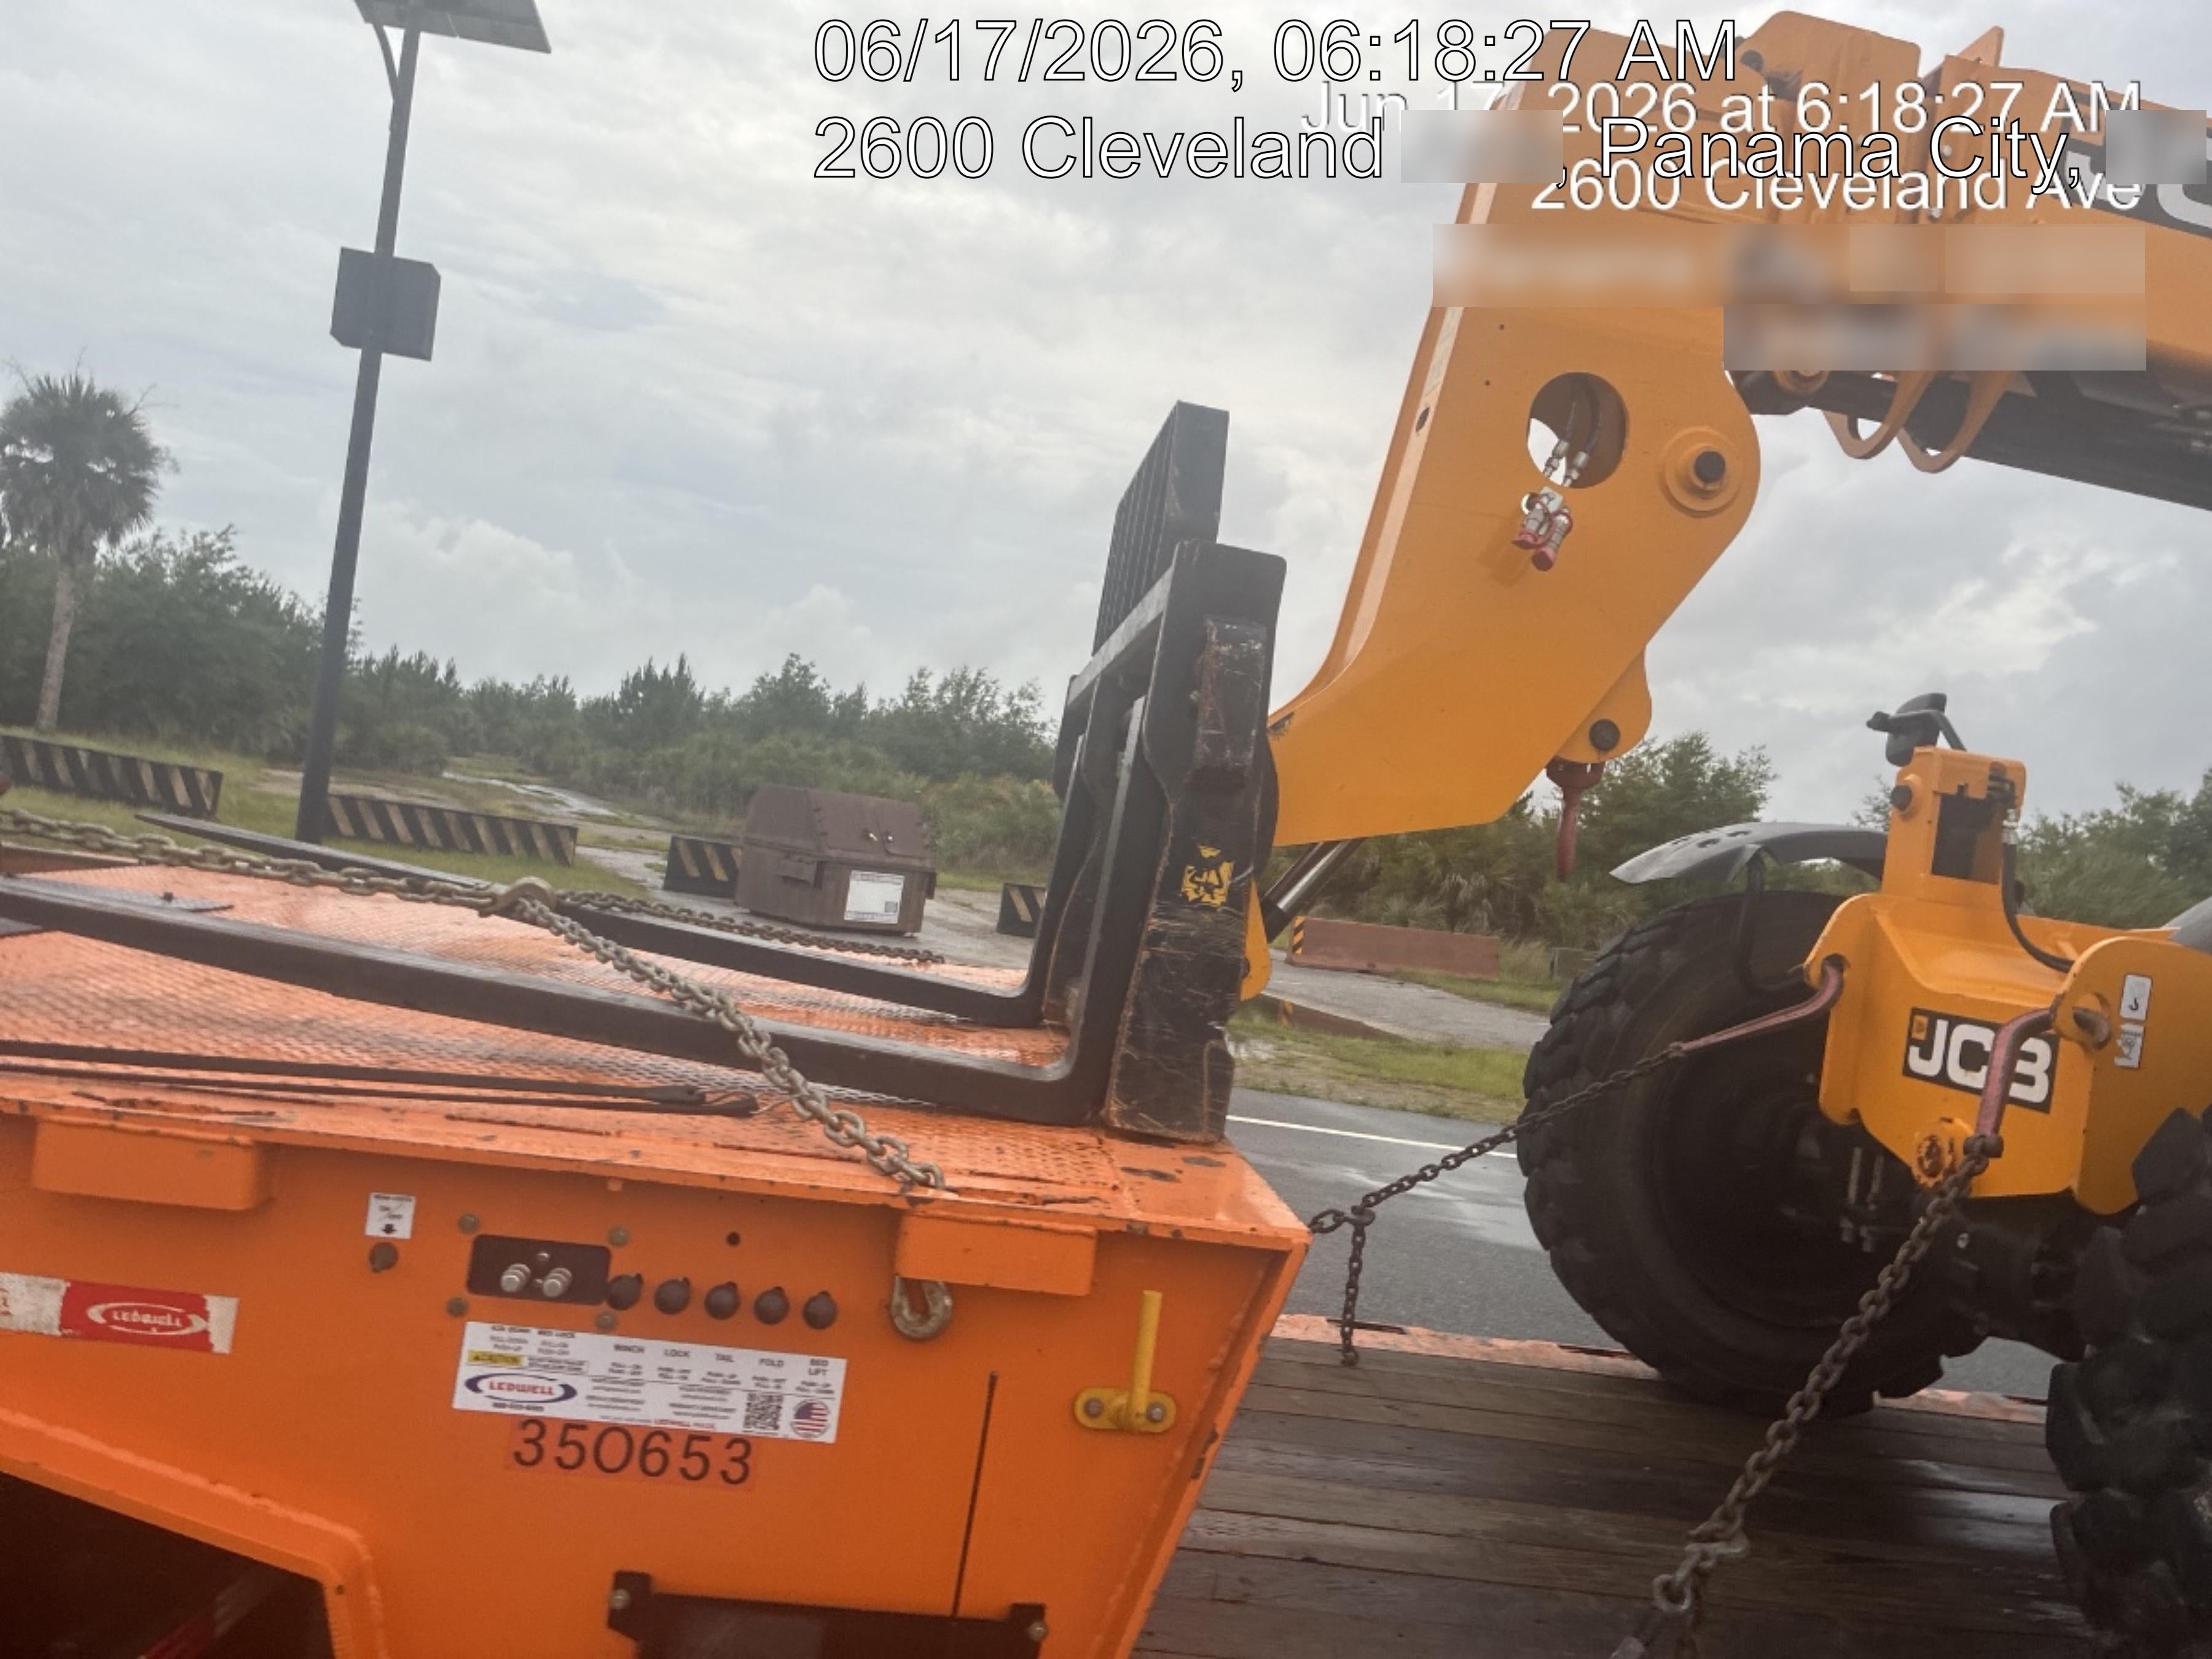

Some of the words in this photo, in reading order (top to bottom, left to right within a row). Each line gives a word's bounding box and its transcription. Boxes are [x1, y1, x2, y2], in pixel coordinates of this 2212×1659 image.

[664, 1349, 690, 1359] LOCK
[759, 1358, 784, 1368] FOLD
[489, 1381, 555, 1396] LEDWELL
